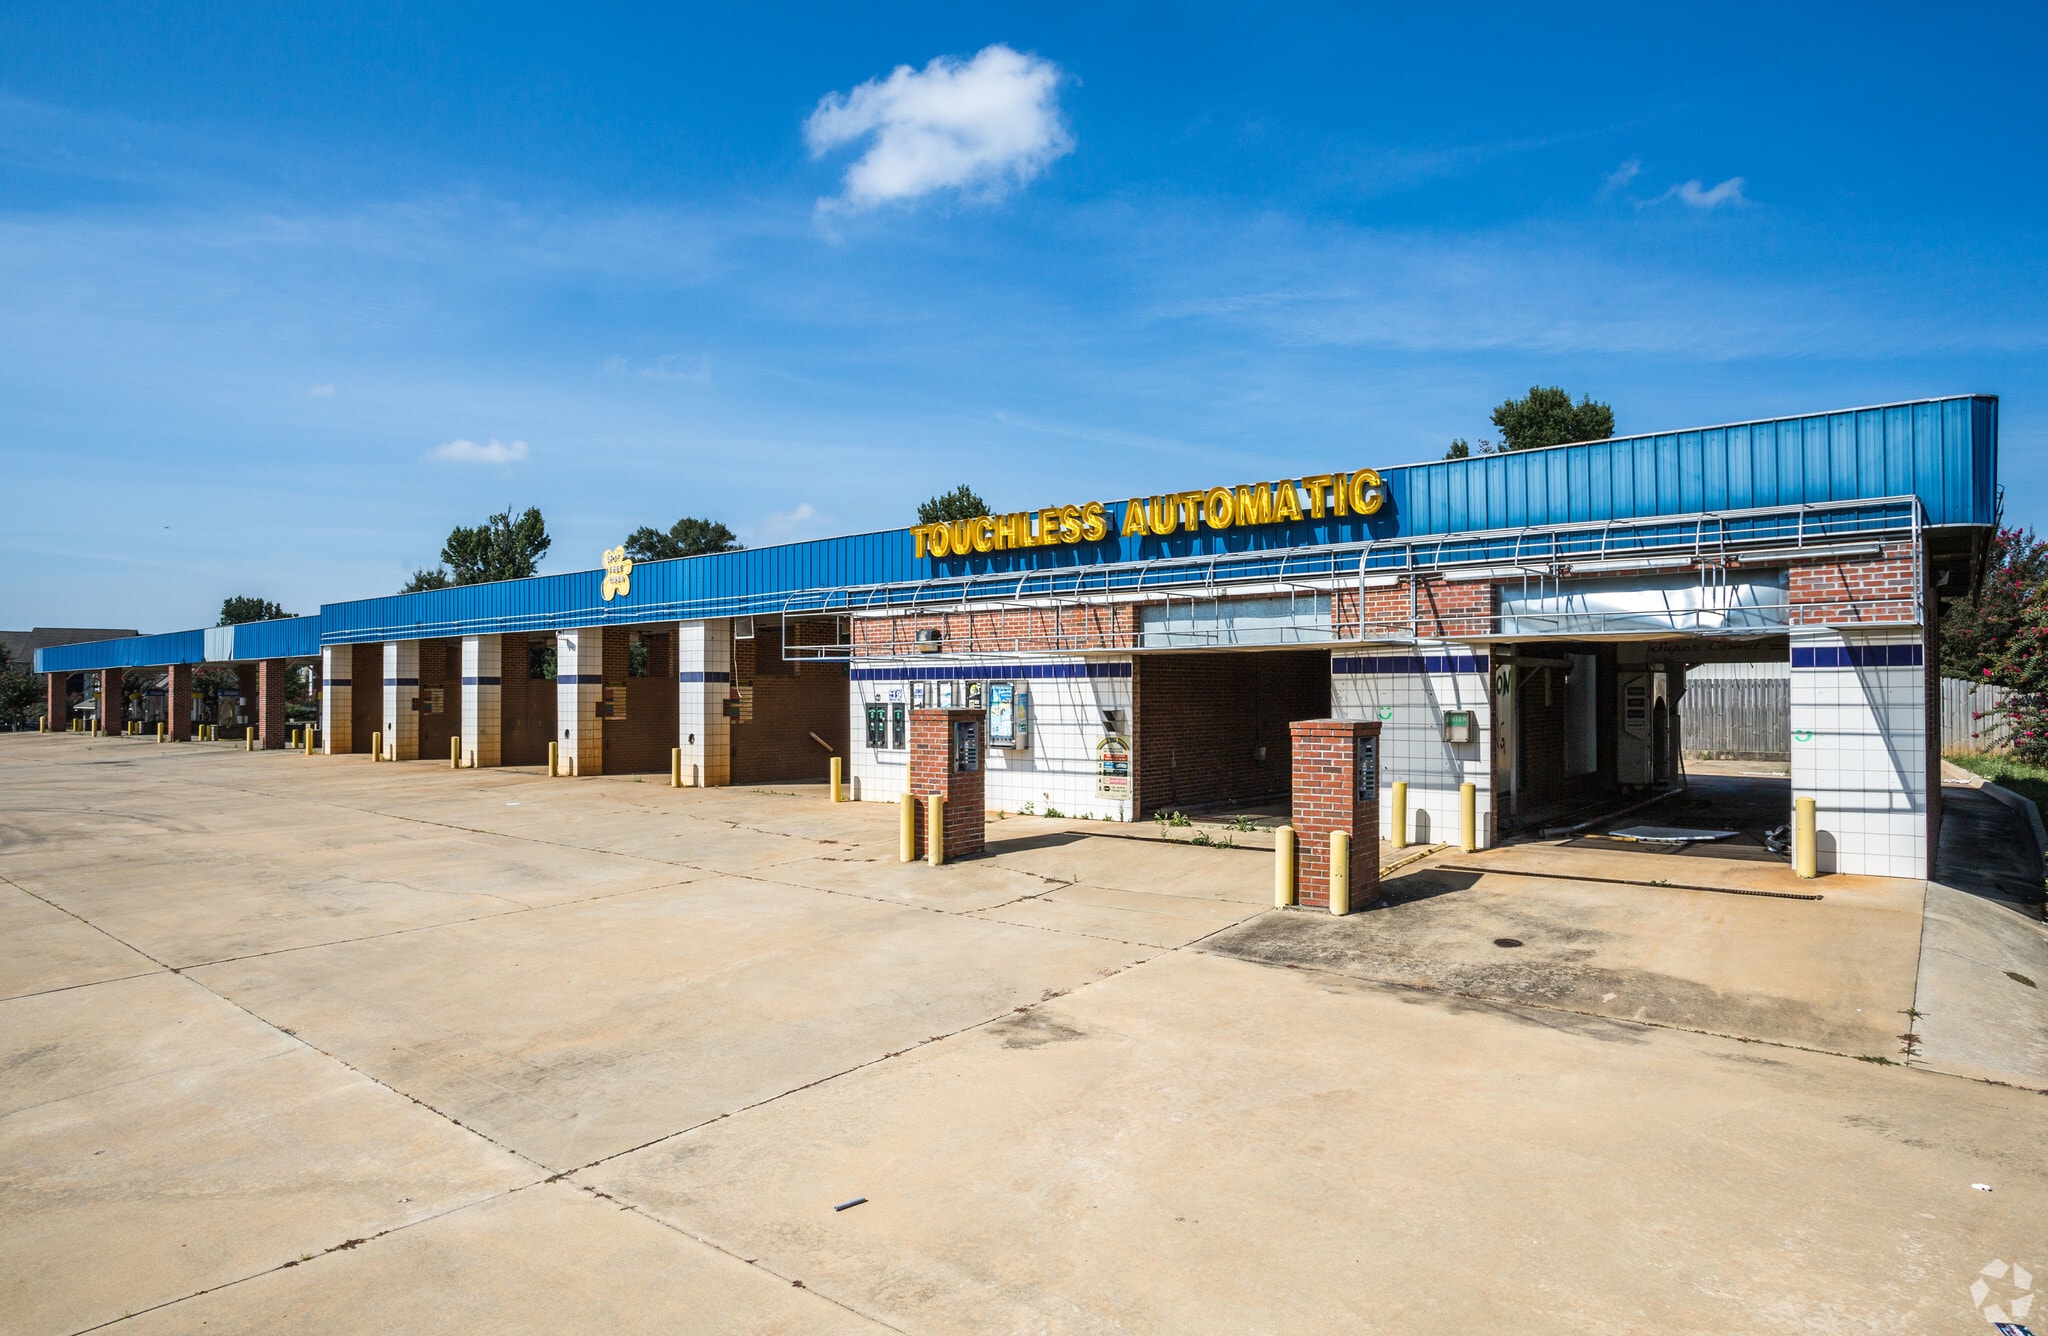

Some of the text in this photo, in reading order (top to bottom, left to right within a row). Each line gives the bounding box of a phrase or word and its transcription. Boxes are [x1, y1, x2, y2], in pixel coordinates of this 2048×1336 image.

[910, 468, 1384, 558] TOUCHLESS AUTOMATIC
[1651, 640, 1761, 654] Super Comet
